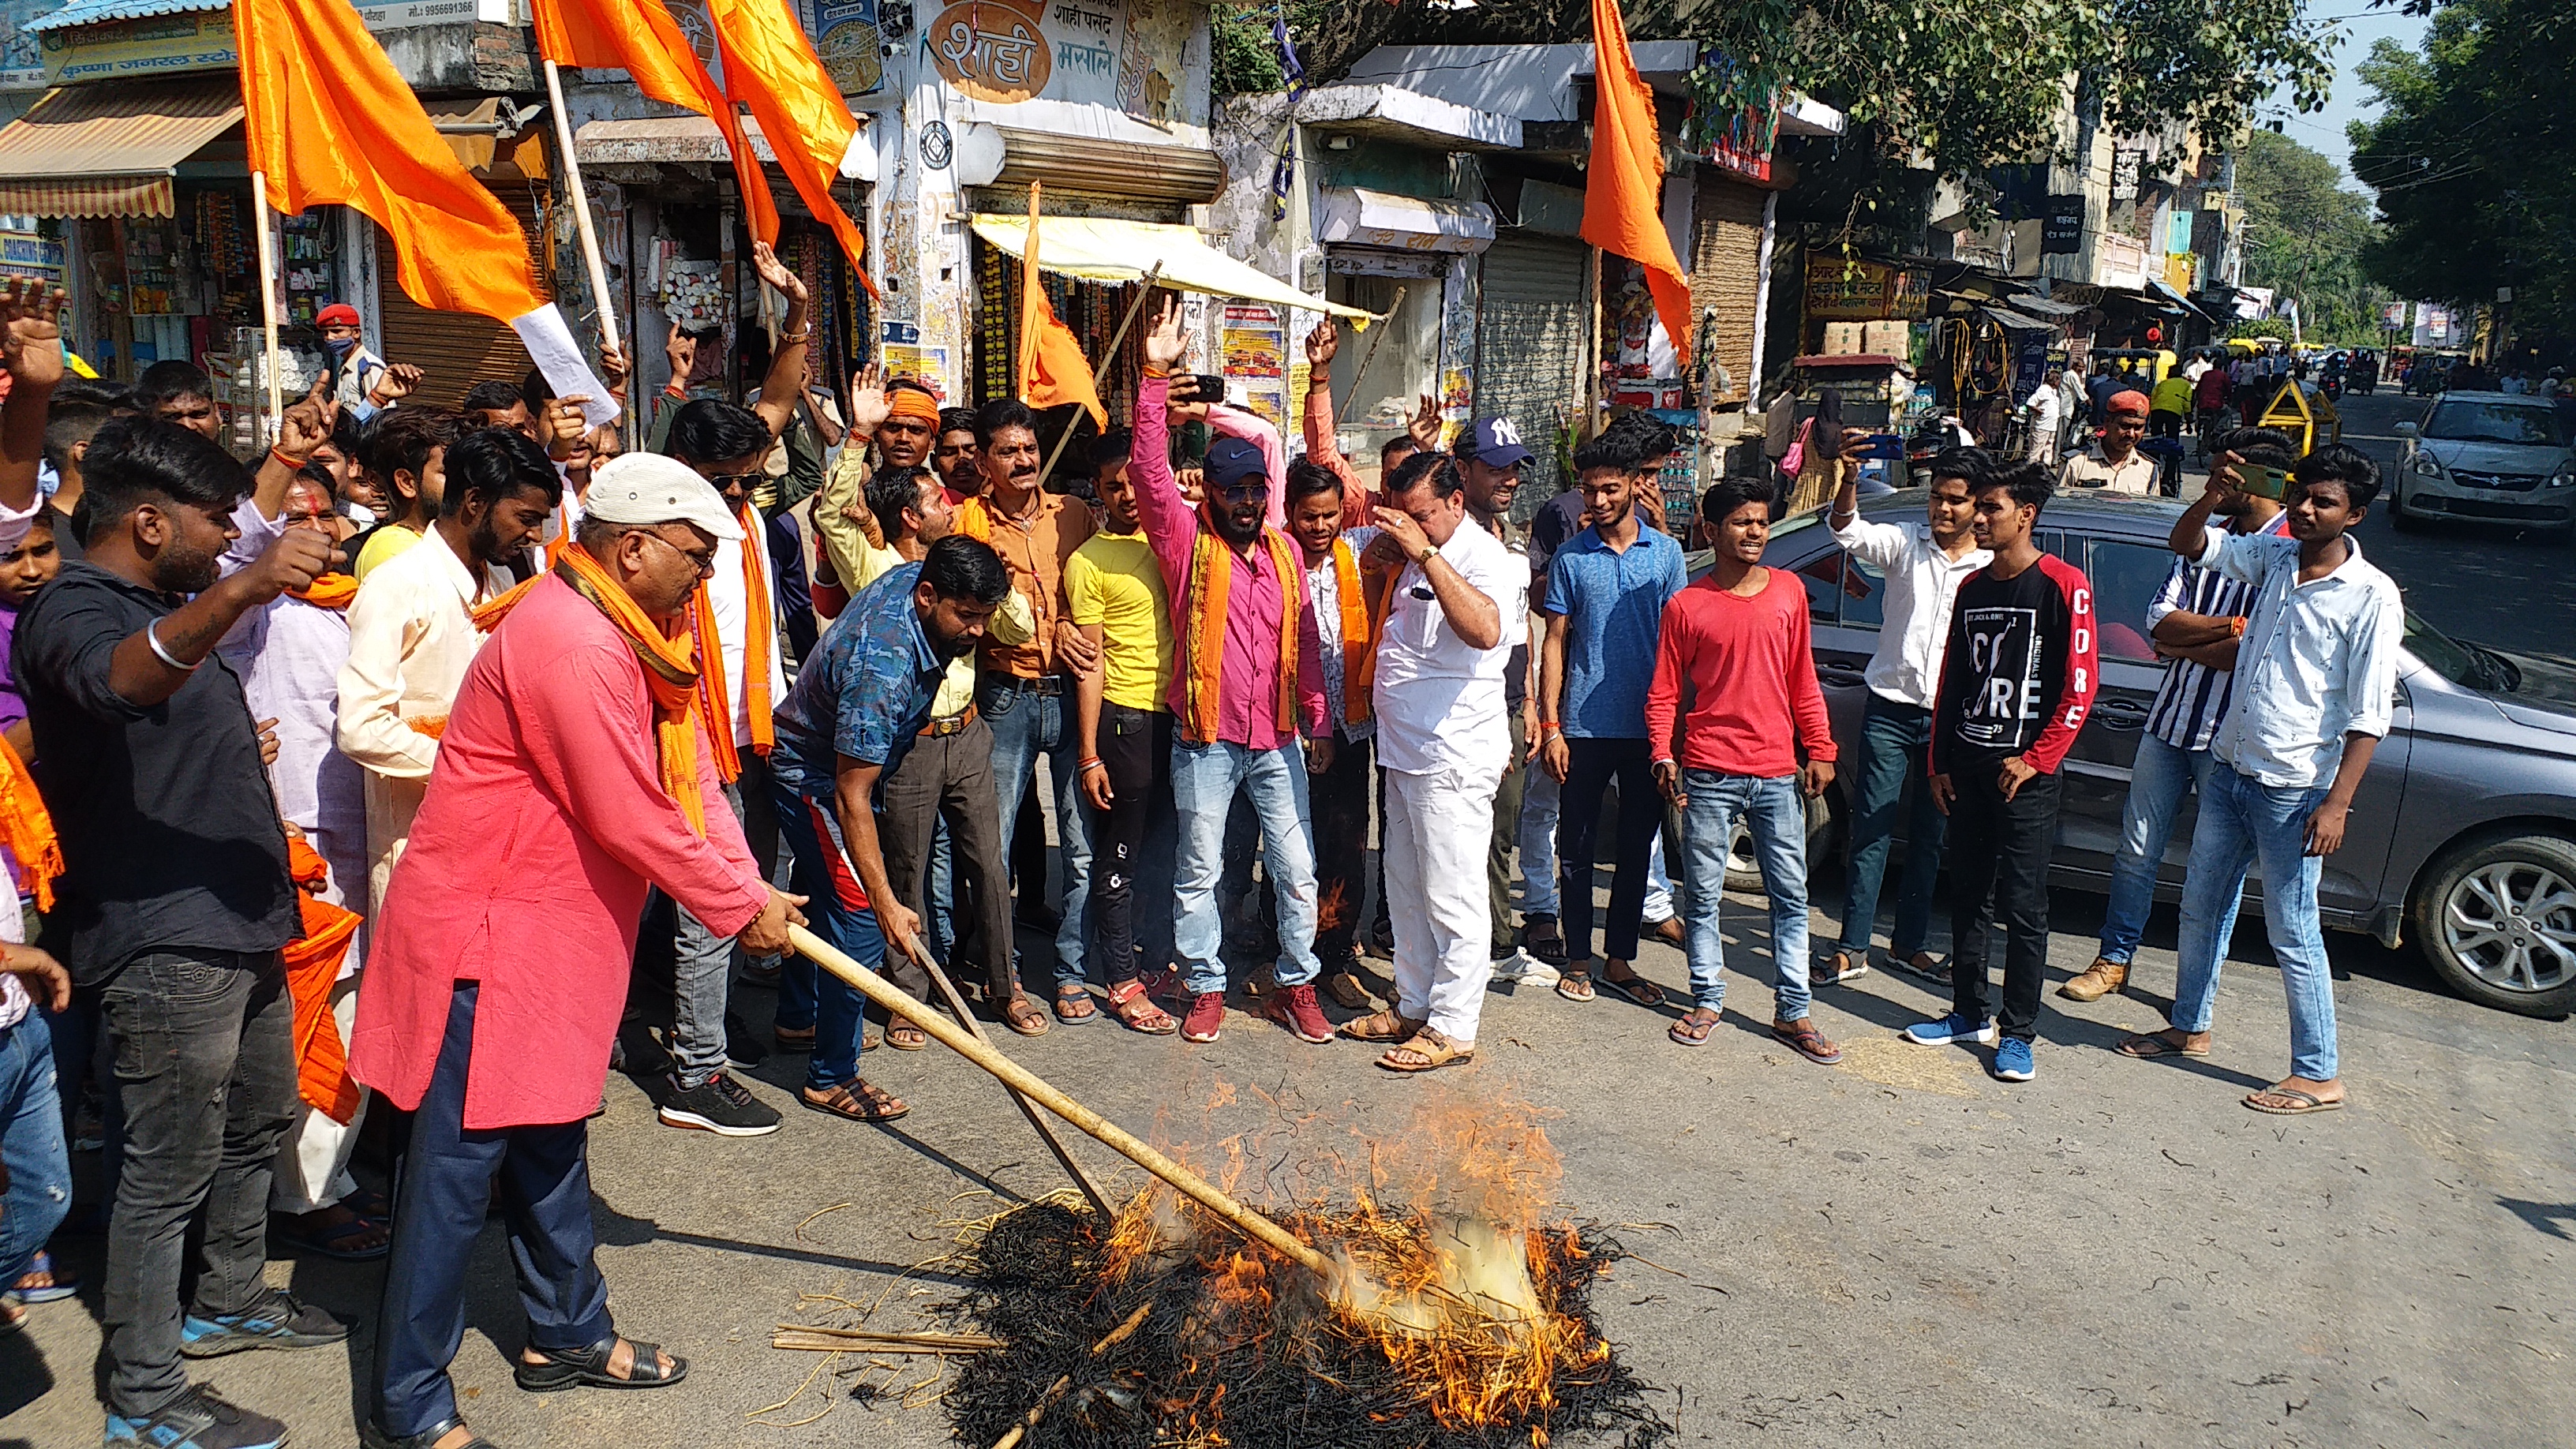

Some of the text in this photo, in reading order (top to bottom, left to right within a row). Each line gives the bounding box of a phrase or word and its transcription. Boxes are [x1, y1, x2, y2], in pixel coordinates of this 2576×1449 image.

[425, 1, 473, 17] 9956691366
[1054, 4, 1114, 37] शाही पसंद
[62, 60, 113, 80] कृष्णा
[118, 54, 190, 71] जनरल
[942, 21, 1037, 84] शाही
[1057, 40, 1116, 80] मसाले
[2064, 588, 2090, 729] CORE
